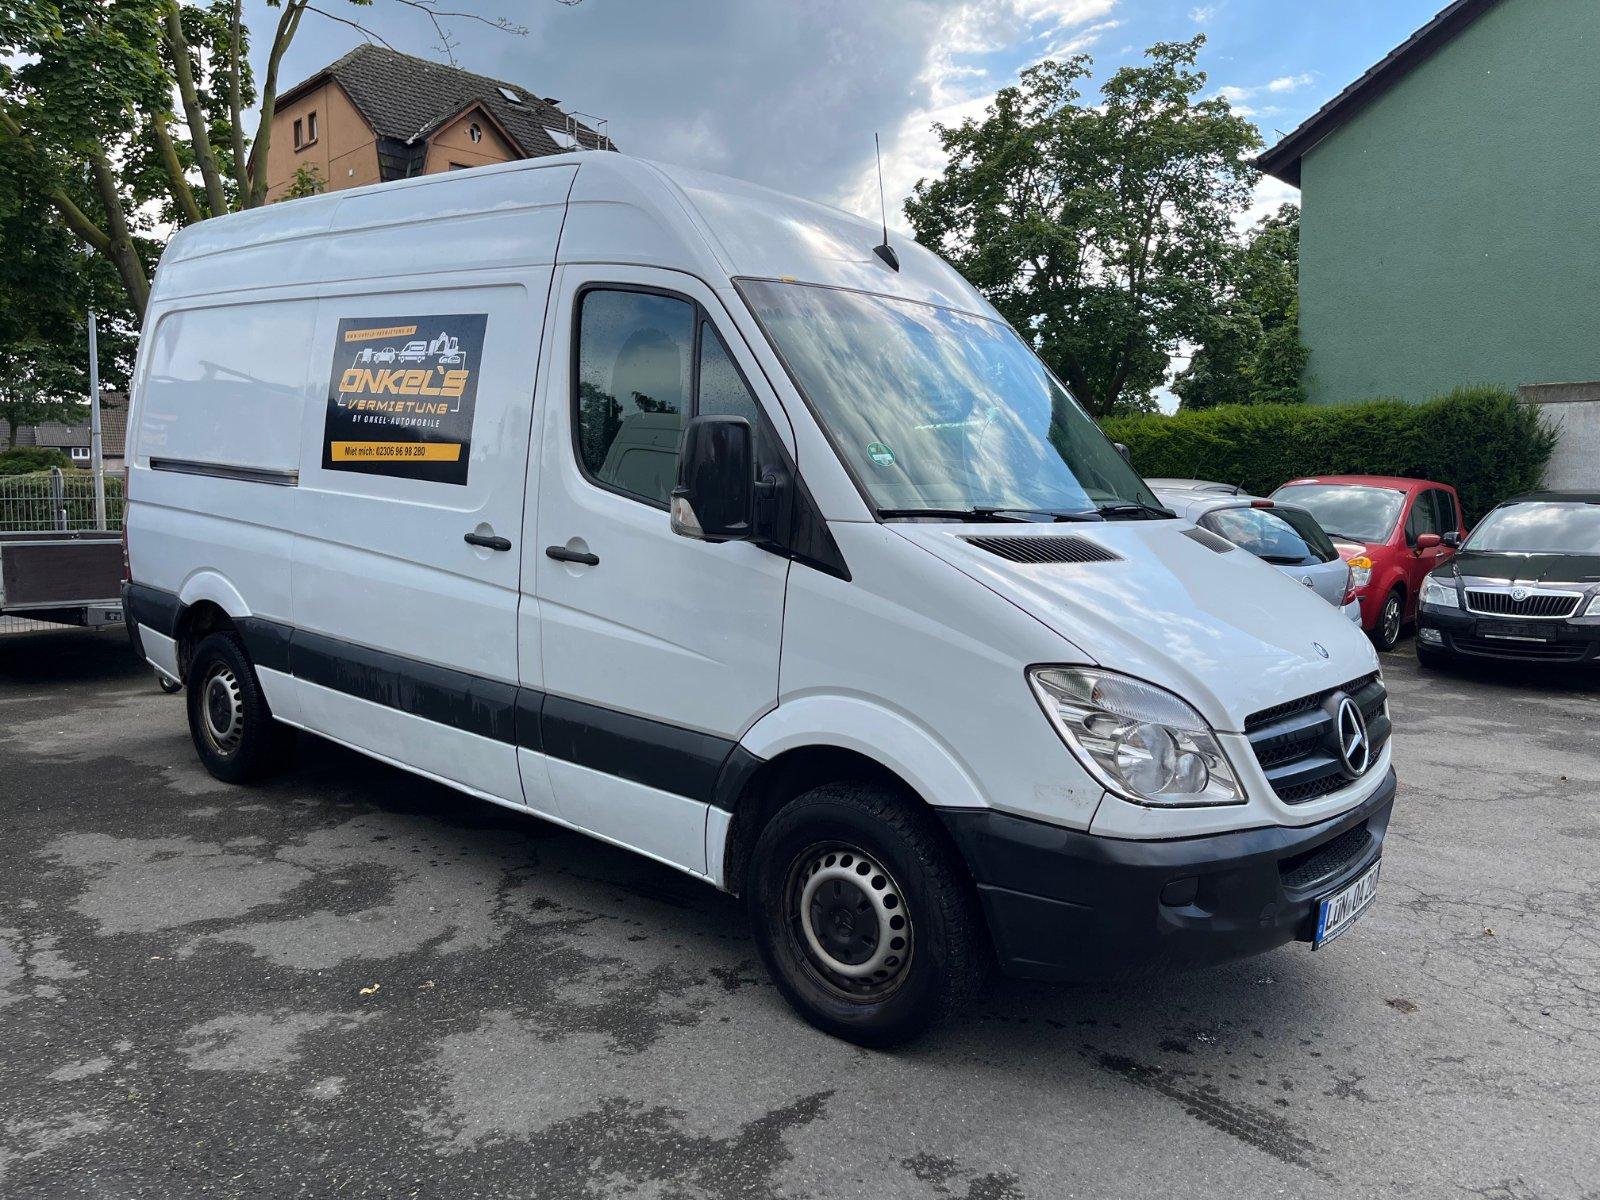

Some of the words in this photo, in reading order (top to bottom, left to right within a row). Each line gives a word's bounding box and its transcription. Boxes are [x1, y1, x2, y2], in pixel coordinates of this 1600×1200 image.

[347, 399, 448, 414] VERMIETUNG
[352, 415, 361, 423] BY
[364, 415, 440, 428] ONKEL-AUTOMOBILE
[344, 446, 357, 456] Miet
[359, 446, 375, 457] mich:
[375, 446, 395, 457] 02306
[395, 447, 404, 456] 96
[404, 447, 413, 456] 98
[413, 447, 426, 457] 280
[1325, 892, 1349, 930] LÜN
